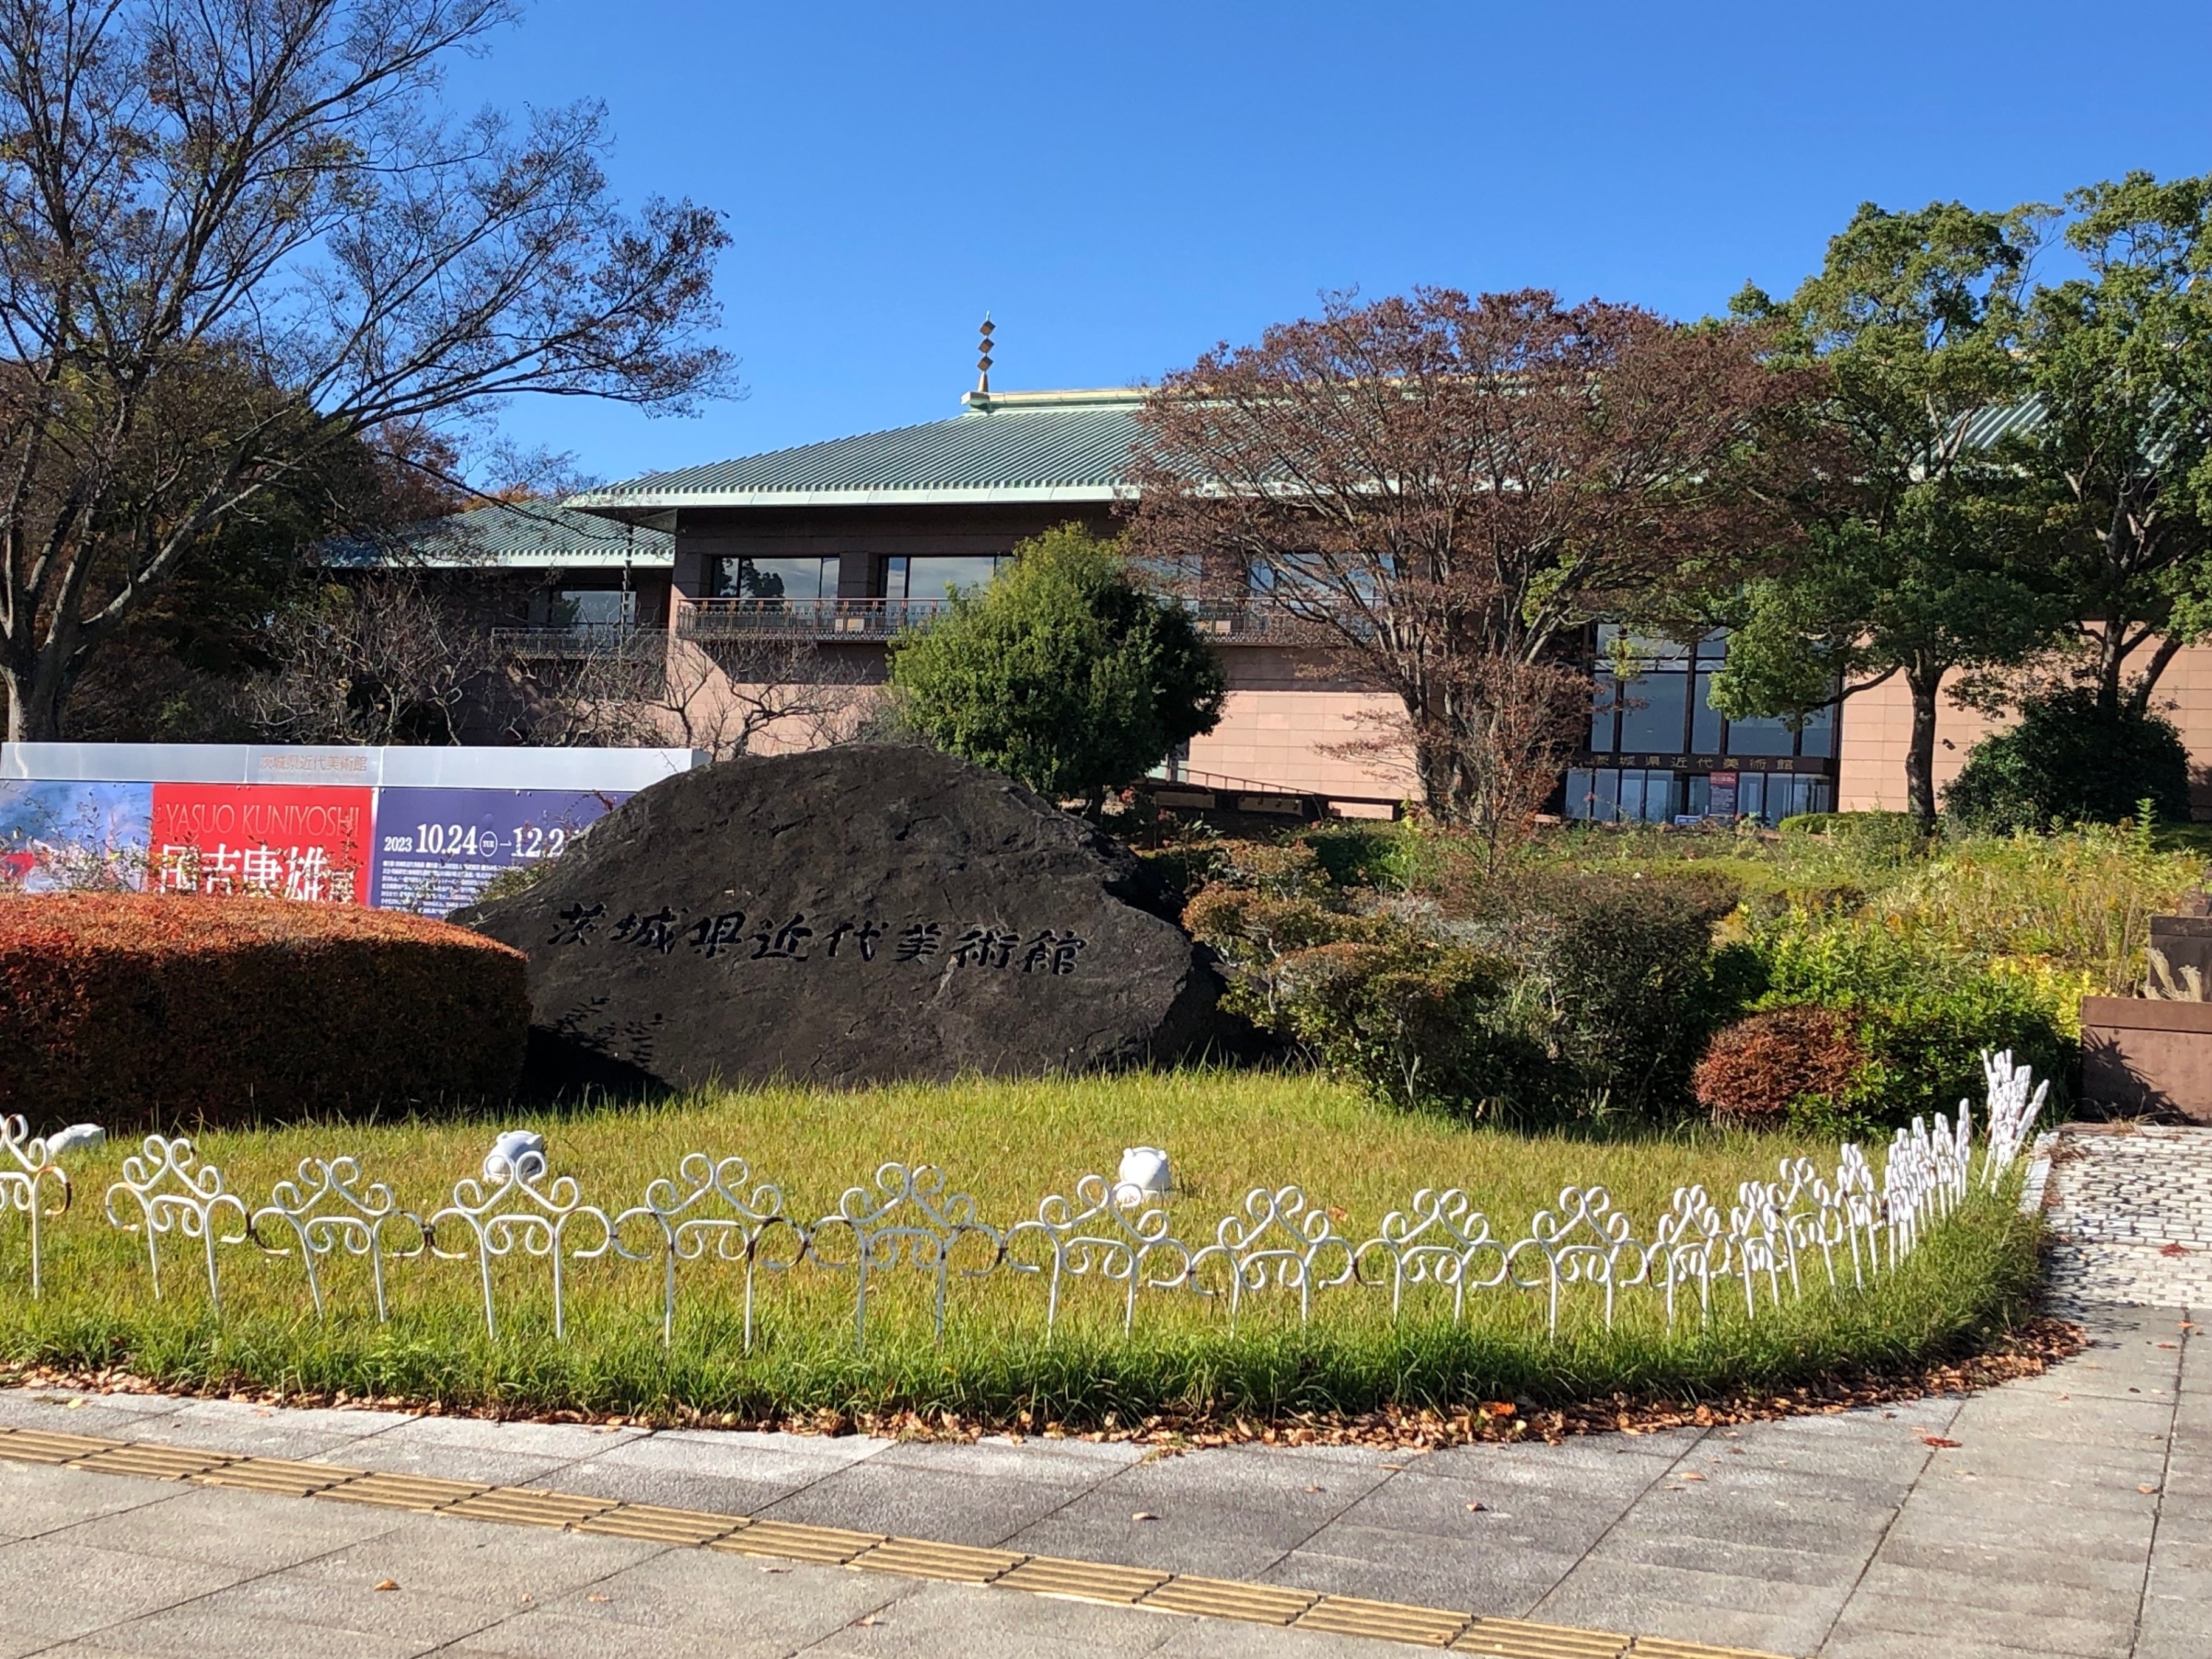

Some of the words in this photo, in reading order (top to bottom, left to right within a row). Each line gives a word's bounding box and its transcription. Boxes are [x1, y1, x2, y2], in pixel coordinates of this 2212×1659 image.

[259, 755, 368, 772] 茨城県近代美術館
[165, 803, 235, 835] YASUO
[242, 805, 359, 837] KUNIYOSHI
[383, 836, 413, 853] 2023
[415, 823, 478, 855] 10.24
[511, 826, 579, 858] 12.2
[547, 902, 1087, 975] 茨城県近代美術館
